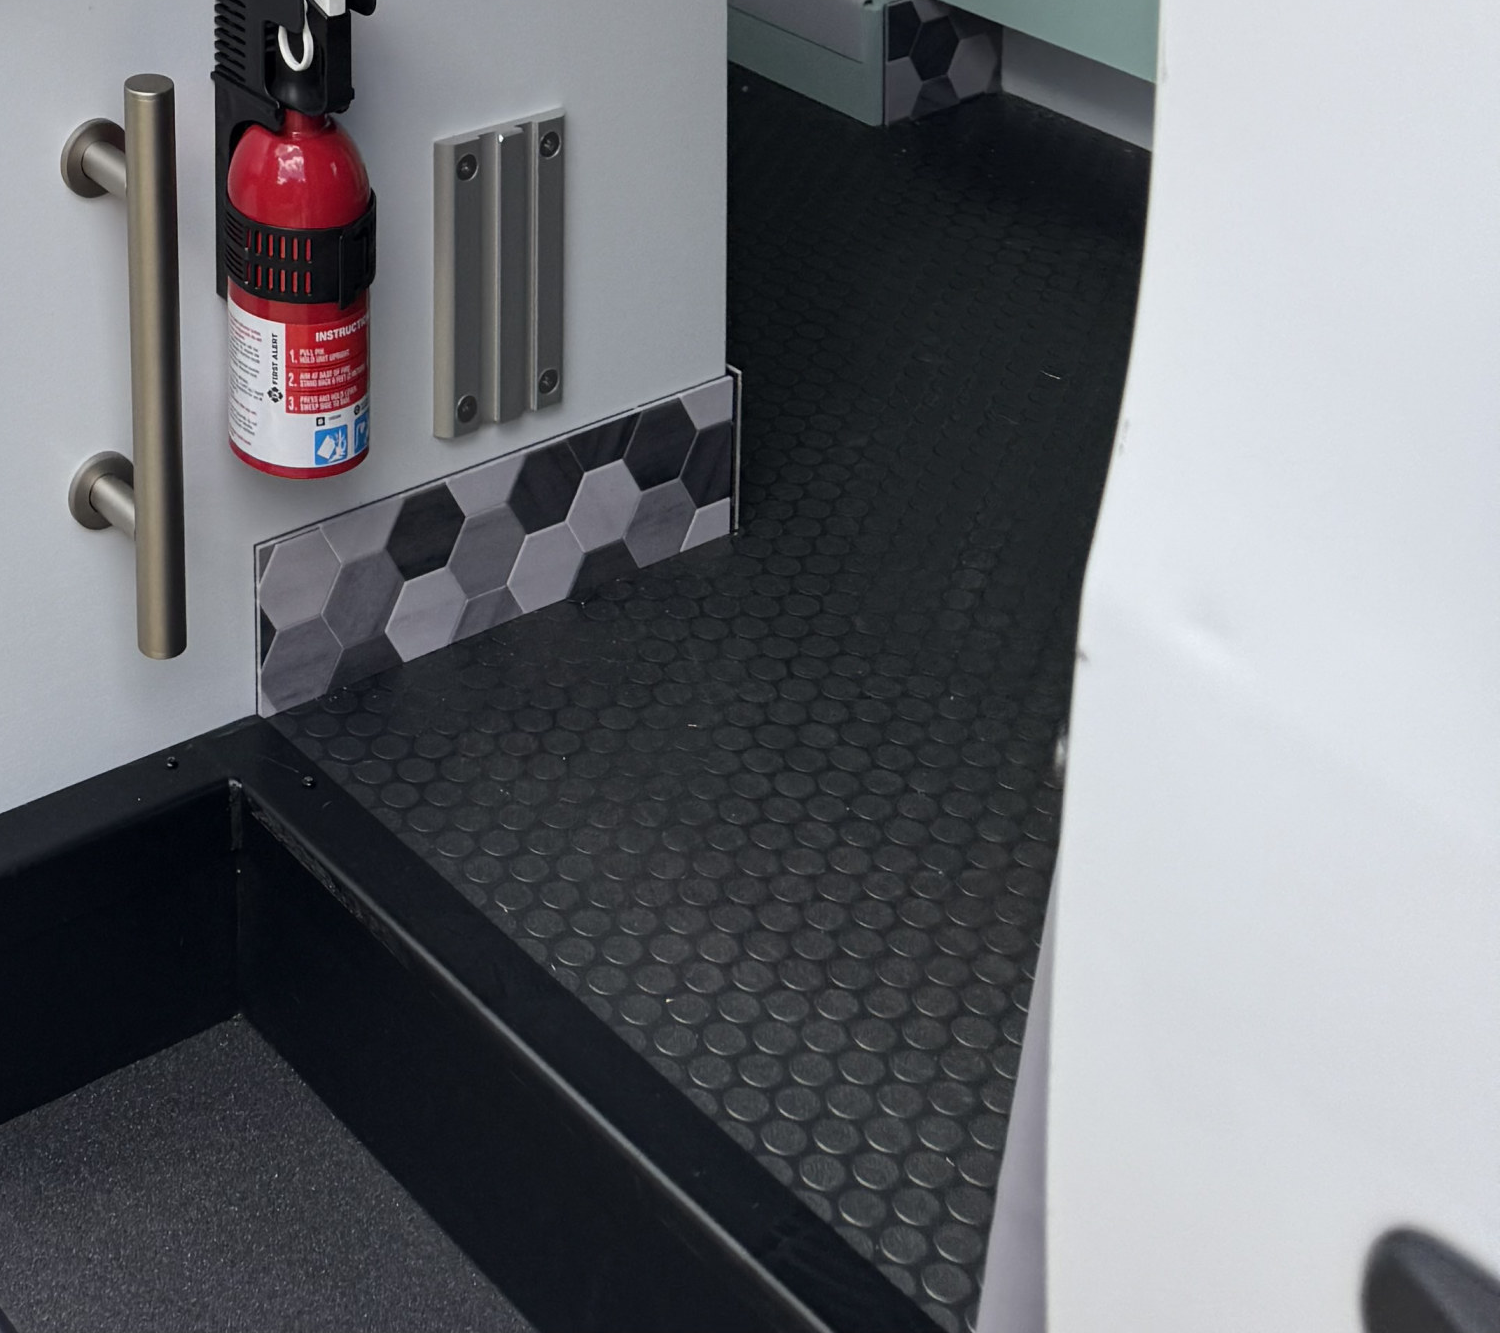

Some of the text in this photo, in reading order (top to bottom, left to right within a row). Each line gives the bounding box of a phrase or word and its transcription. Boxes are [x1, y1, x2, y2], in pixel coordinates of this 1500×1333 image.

[289, 348, 298, 364] 1.
[288, 372, 297, 387] 2.
[288, 396, 297, 411] 3.
